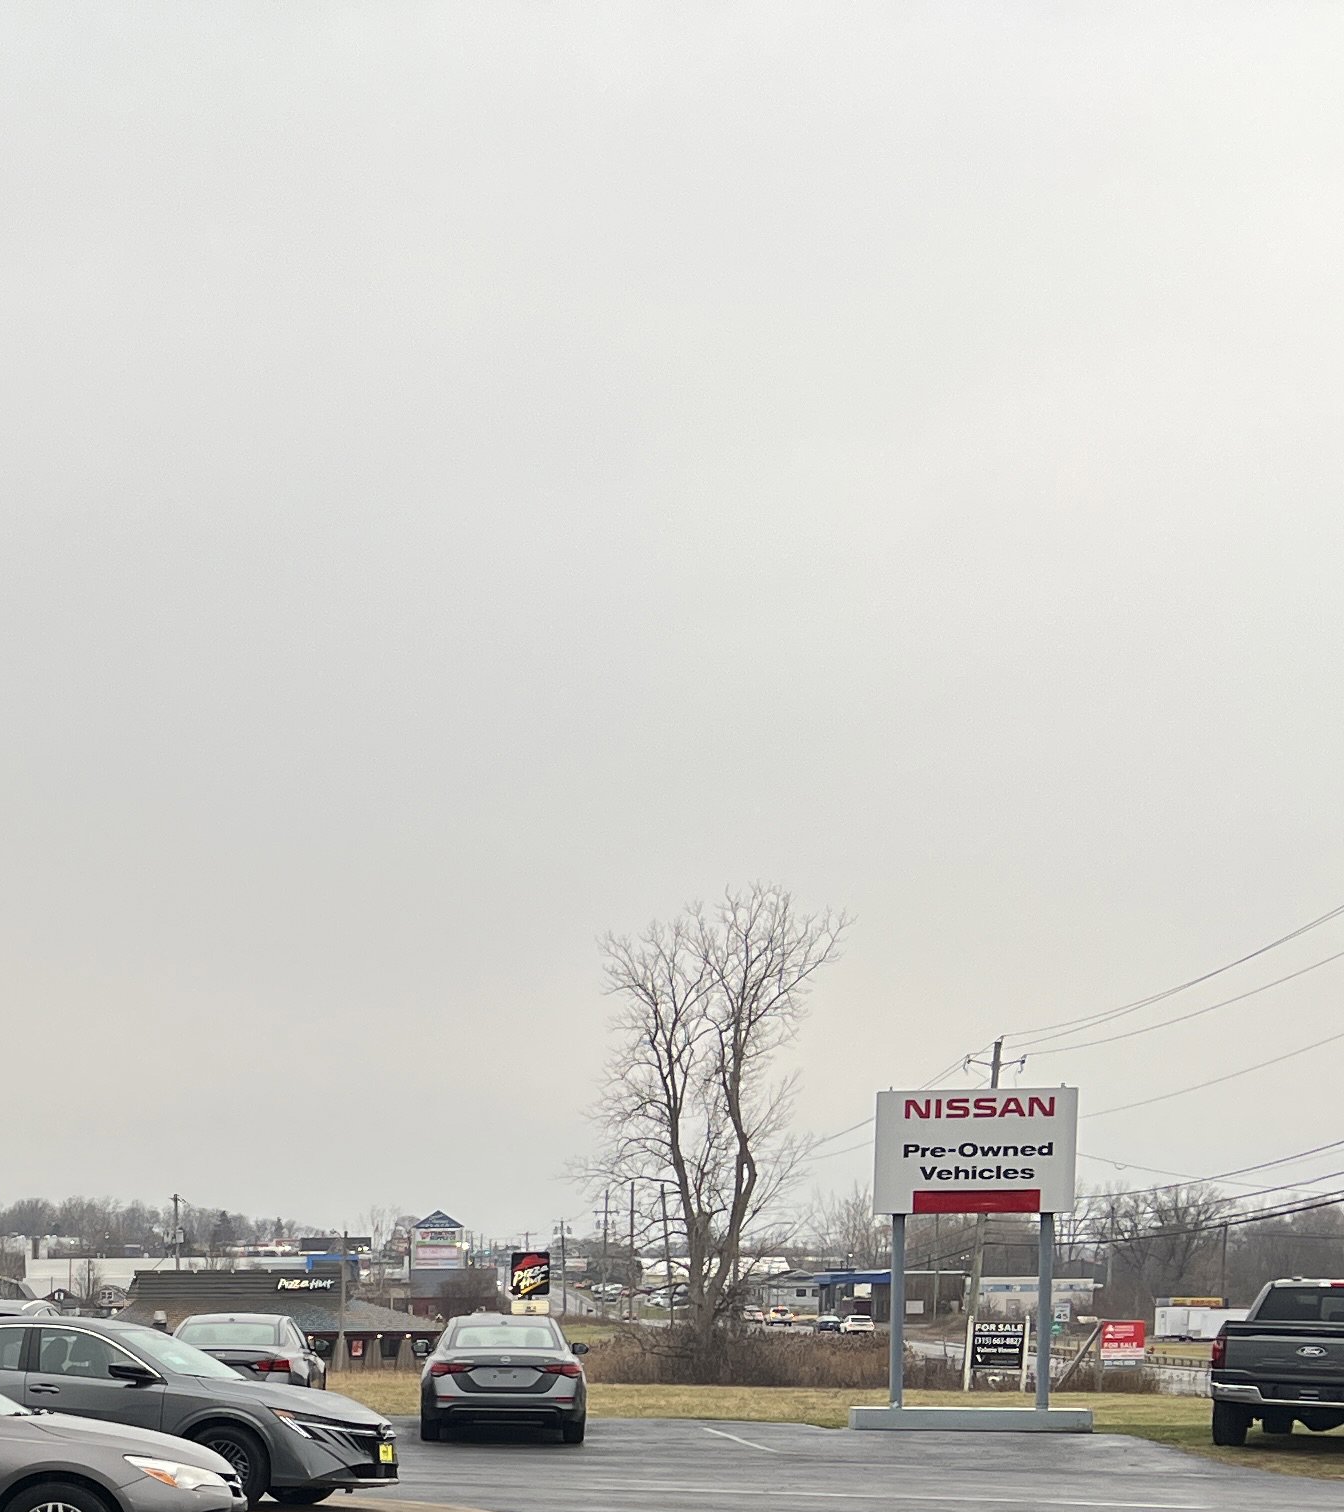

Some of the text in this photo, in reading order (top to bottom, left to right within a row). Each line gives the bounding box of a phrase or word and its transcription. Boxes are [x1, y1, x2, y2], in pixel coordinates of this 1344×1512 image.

[904, 1096, 1055, 1119] NISSAN
[903, 1142, 1054, 1158] Pre-Owned
[920, 1165, 1035, 1180] Vehicles
[513, 1265, 549, 1287] Pizza
[519, 1273, 545, 1289] Hut
[975, 1323, 1023, 1331] FOR SALE
